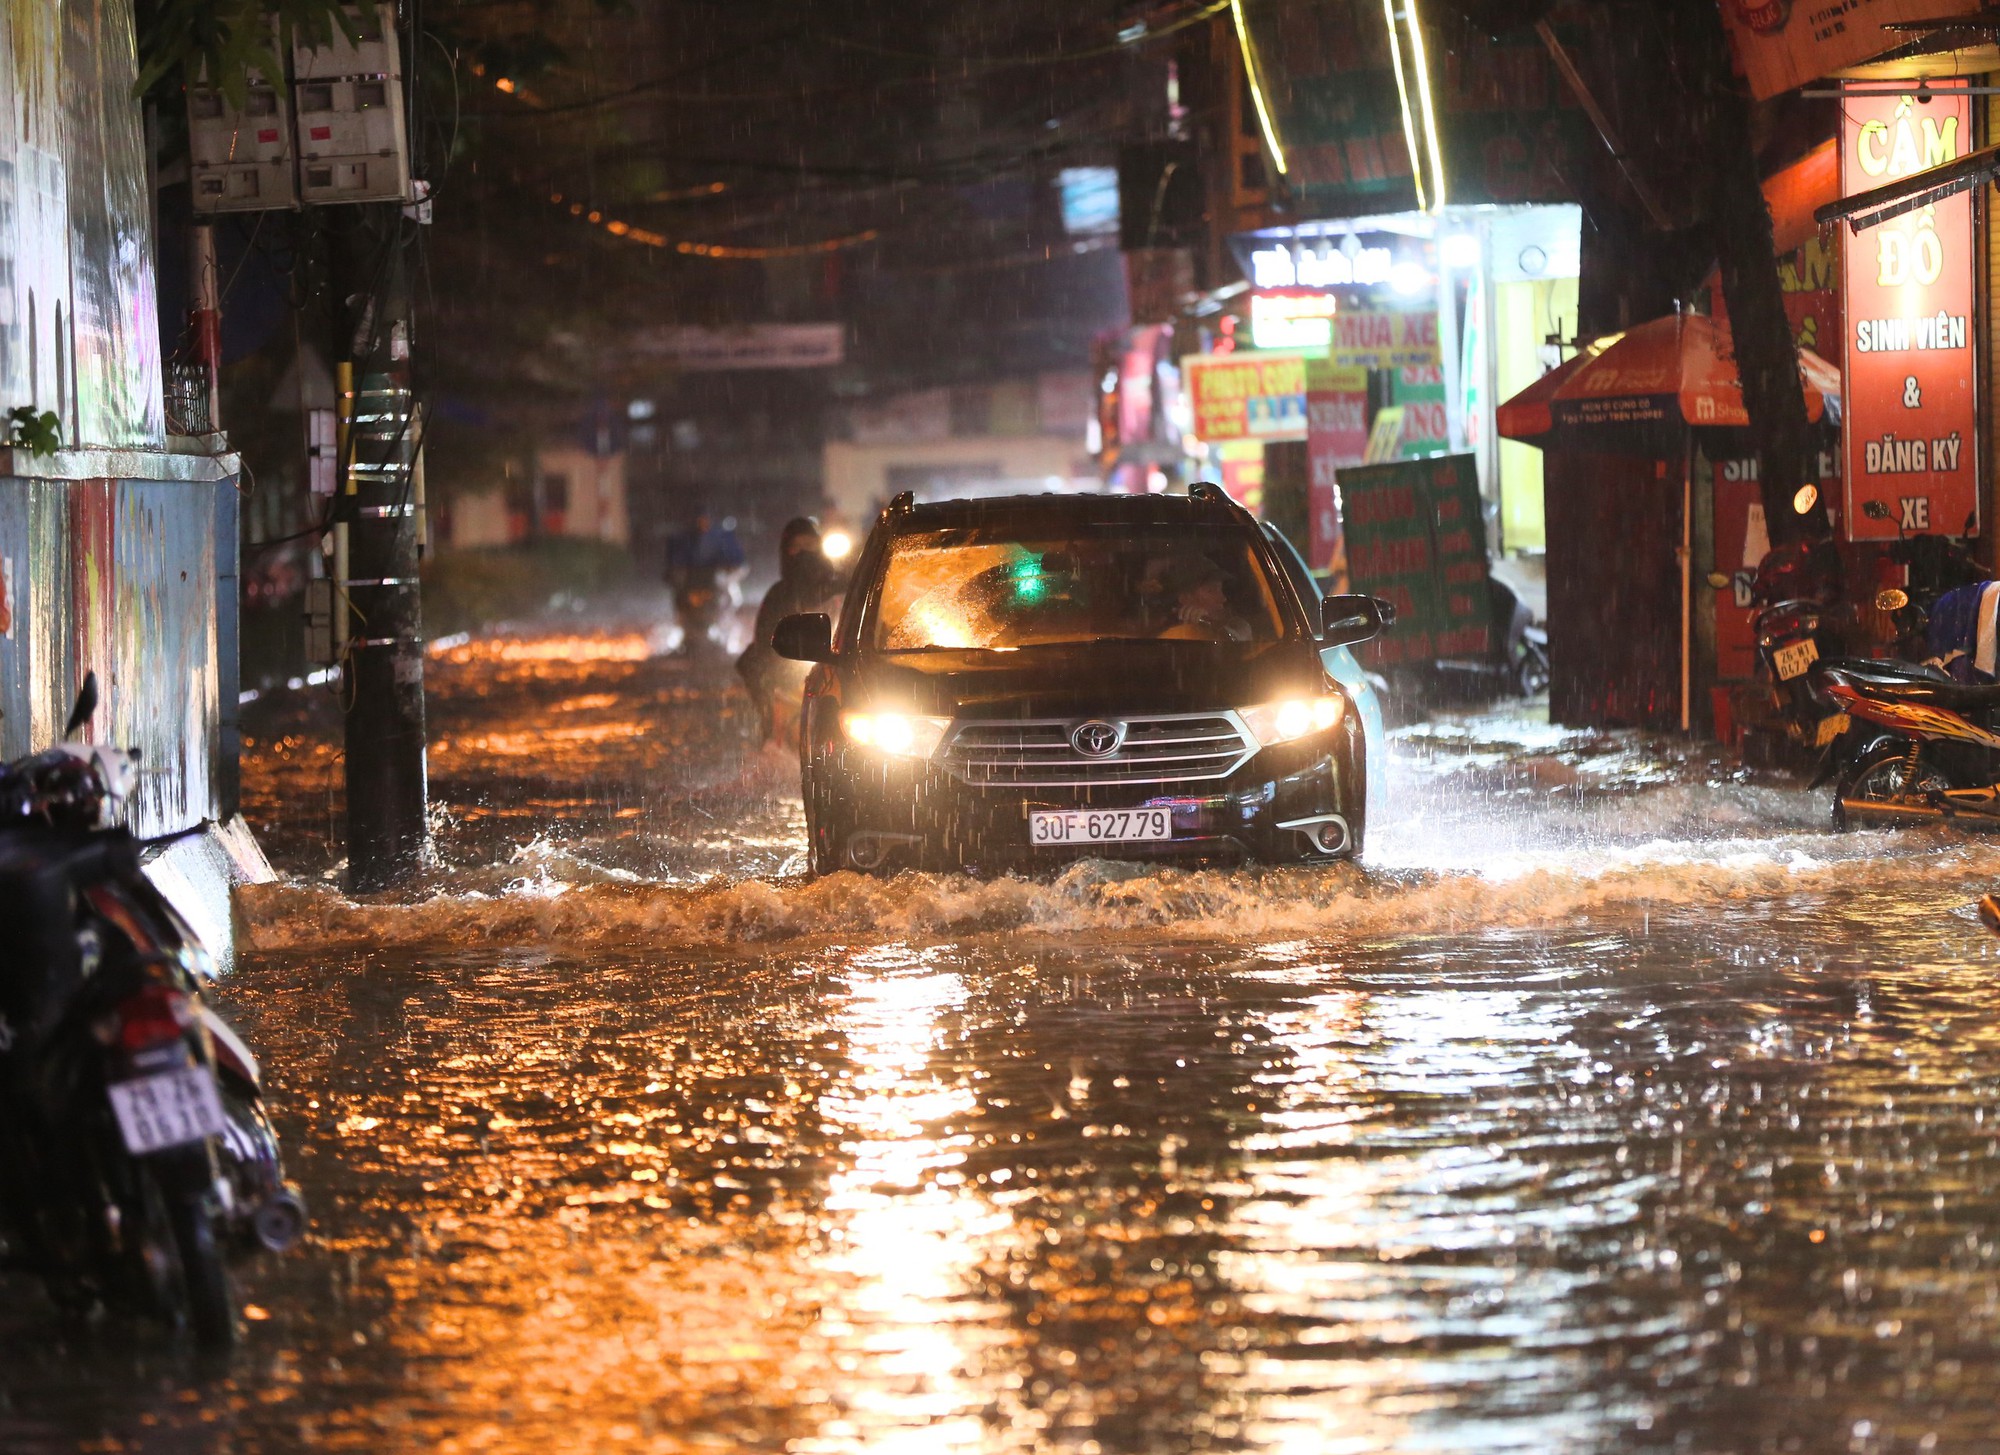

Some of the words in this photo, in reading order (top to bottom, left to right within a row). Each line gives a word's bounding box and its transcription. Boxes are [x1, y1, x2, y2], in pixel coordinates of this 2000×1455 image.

[1857, 95, 1958, 176] CẦM
[1876, 203, 1943, 287] ĐỒ
[1856, 319, 1909, 353] SINH
[1915, 310, 1967, 350] VIÊN
[1903, 376, 1921, 408] &
[1866, 434, 1926, 474] ĐĂNG
[1932, 431, 1961, 470] KÝ
[1902, 497, 1929, 529] XE
[1035, 812, 1165, 841] 30F-627.79
